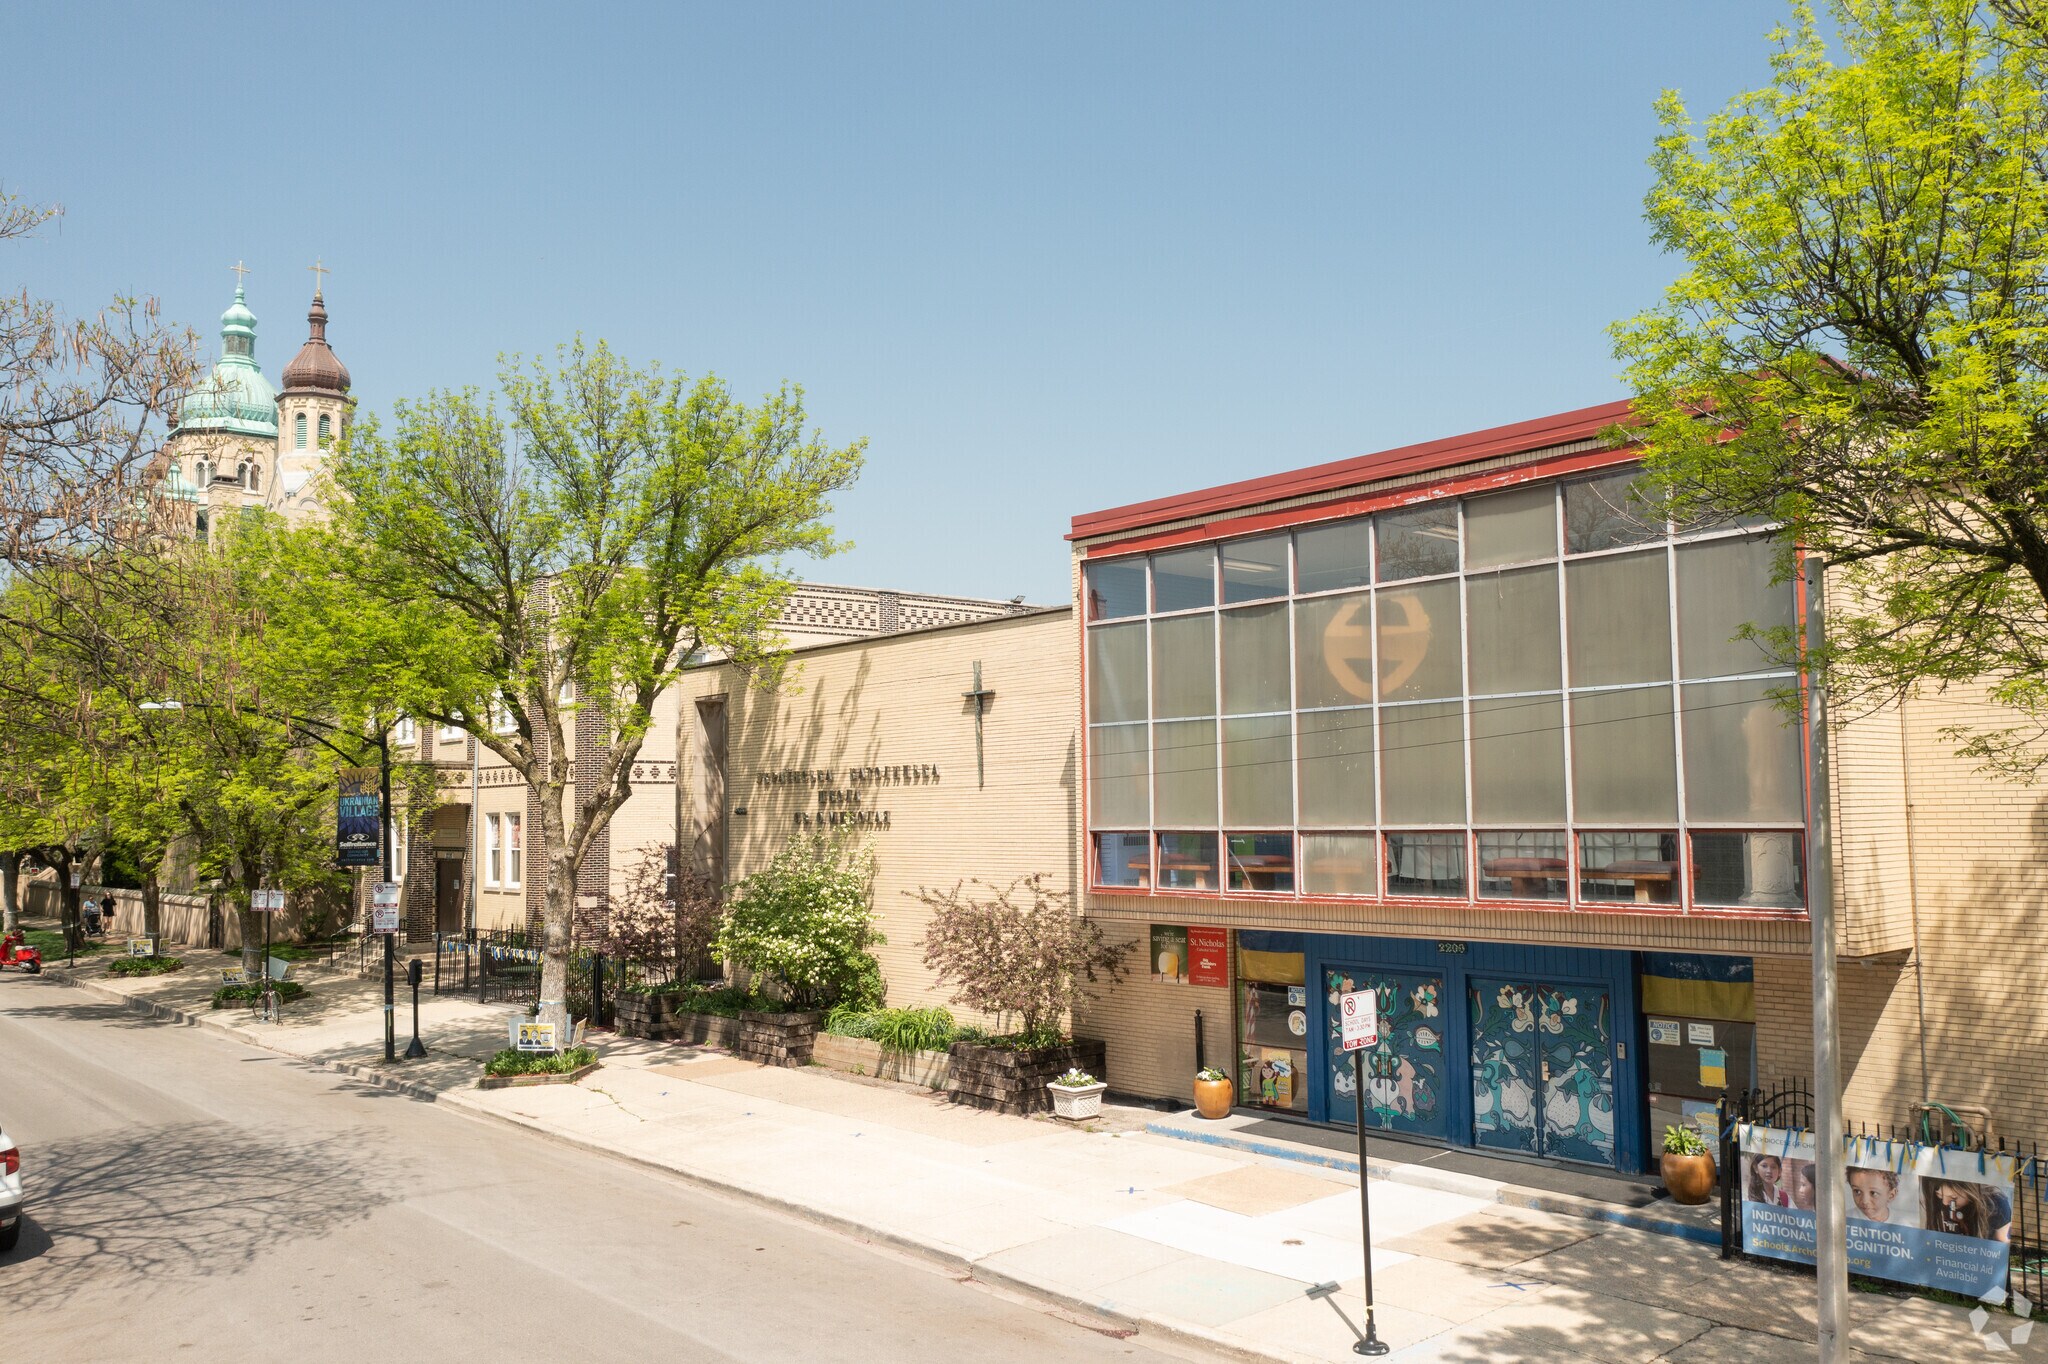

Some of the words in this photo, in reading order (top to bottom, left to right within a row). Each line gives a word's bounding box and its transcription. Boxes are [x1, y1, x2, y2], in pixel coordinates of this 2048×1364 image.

[339, 796, 379, 806] UKRAINIAN
[340, 805, 379, 817] VILLAGE
[1152, 934, 1170, 945] saving
[1175, 936, 1186, 944] seat
[1190, 937, 1198, 947] St.
[1199, 938, 1225, 948] Nicholas
[1653, 1021, 1676, 1030] NOTICE
[1346, 1039, 1358, 1049] TOW
[1845, 1224, 1905, 1244] TENTION.
[1752, 1222, 1815, 1243] NATIONAL
[1846, 1238, 1914, 1260] OGNITION.
[1934, 1239, 1978, 1255] Register
[1980, 1247, 2001, 1260] Now!
[1935, 1256, 1979, 1273] Financial
[1980, 1265, 1994, 1275] Aid
[1936, 1268, 1978, 1284] Available
